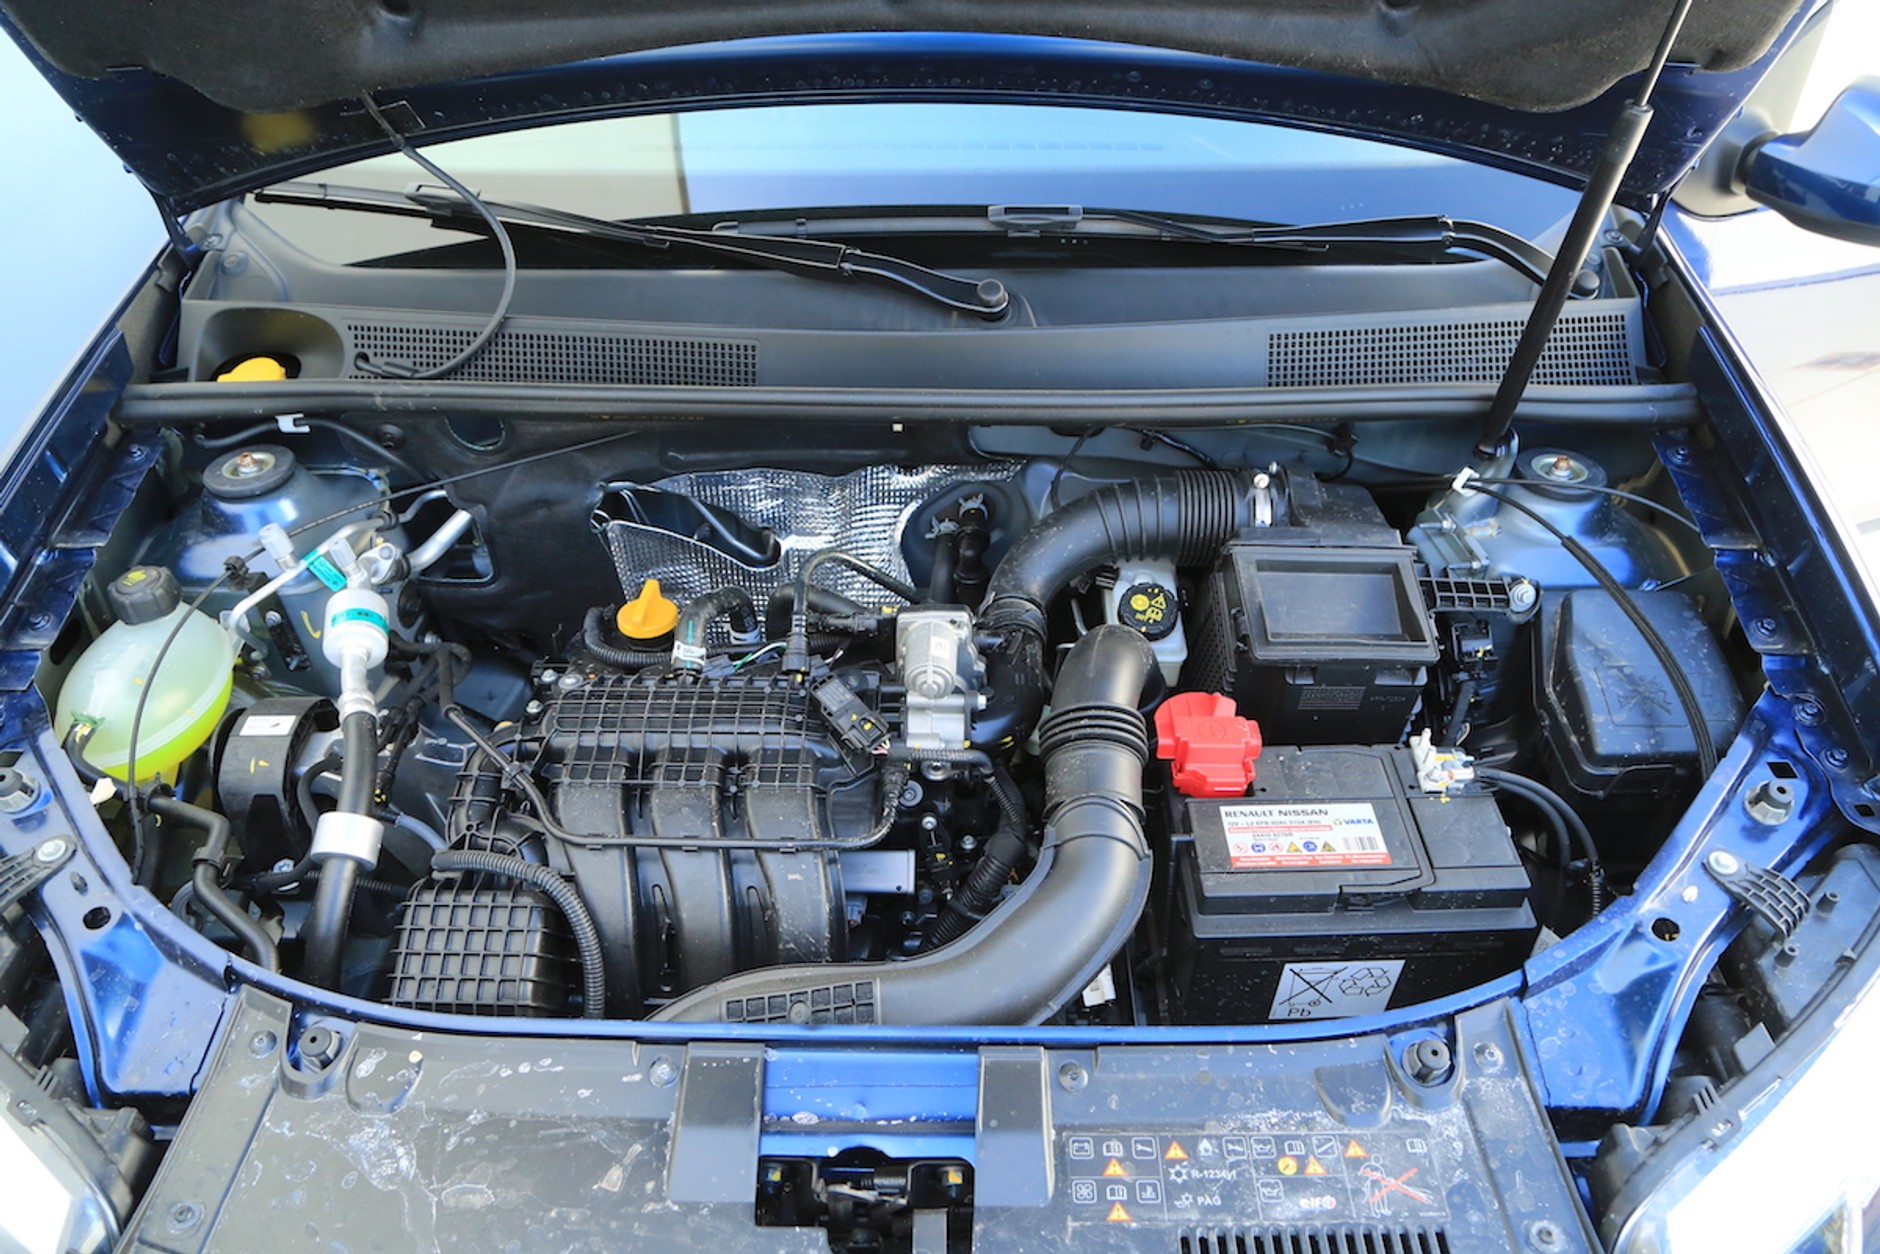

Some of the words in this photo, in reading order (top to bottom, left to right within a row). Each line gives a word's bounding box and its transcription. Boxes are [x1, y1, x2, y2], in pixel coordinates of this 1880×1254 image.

[1224, 809, 1274, 818] RENAULT
[1278, 808, 1329, 817] NISSAN
[1287, 1008, 1311, 1017] Pb
[1197, 1195, 1222, 1206] PAG
